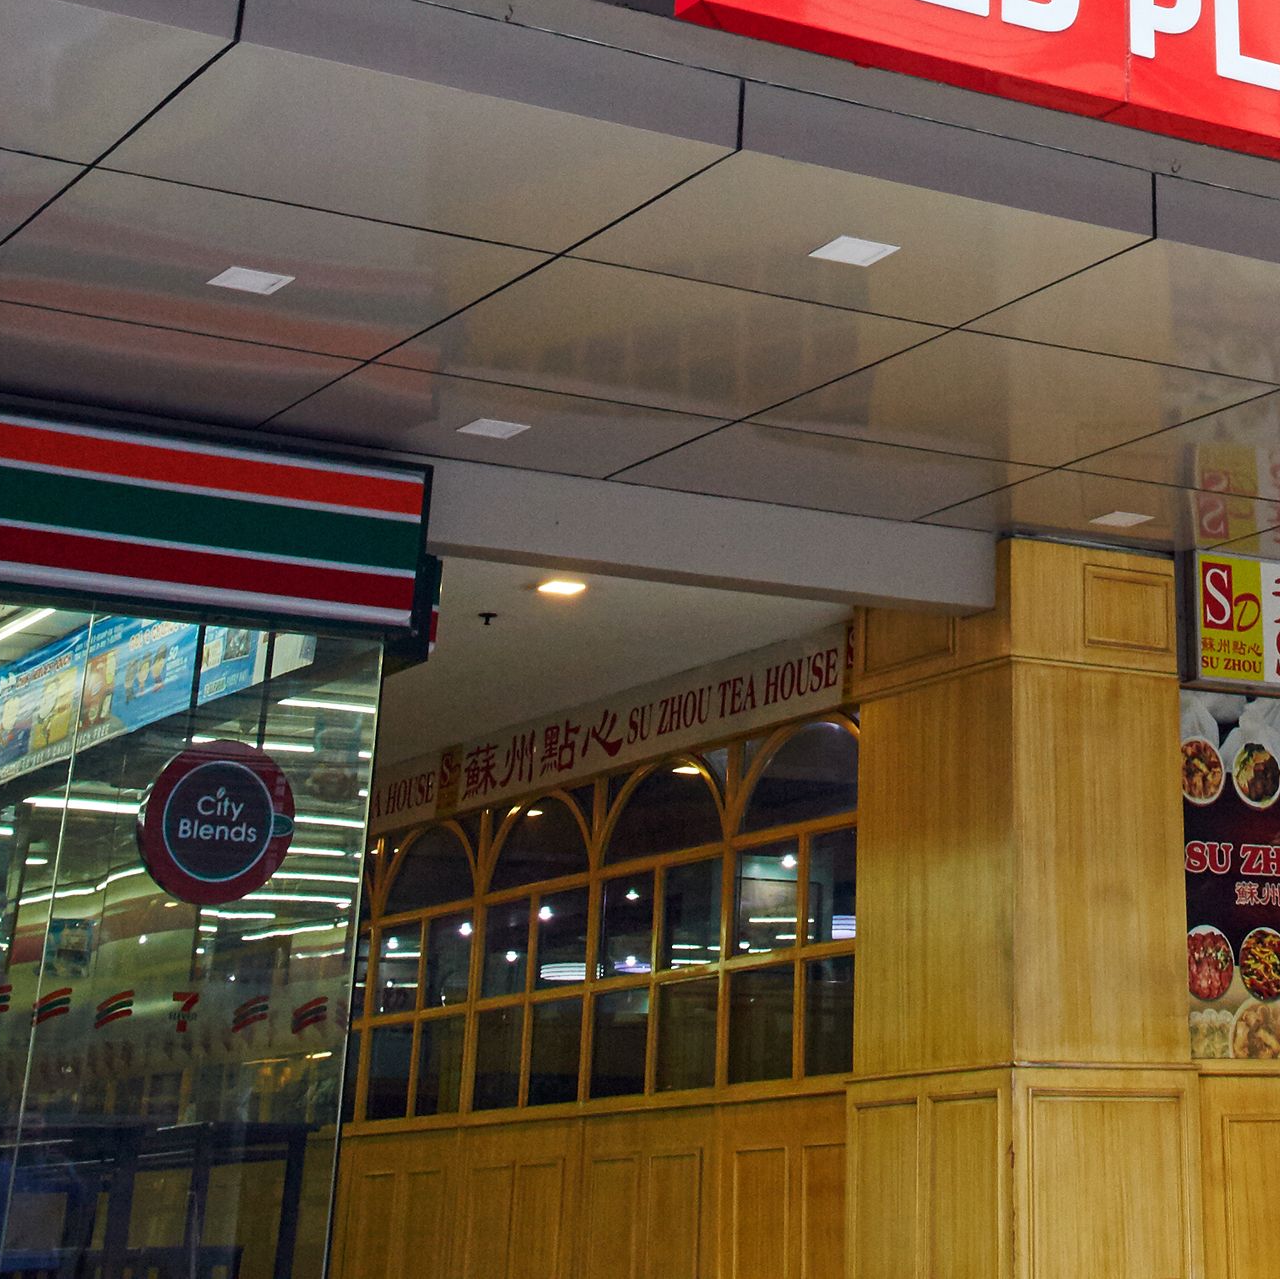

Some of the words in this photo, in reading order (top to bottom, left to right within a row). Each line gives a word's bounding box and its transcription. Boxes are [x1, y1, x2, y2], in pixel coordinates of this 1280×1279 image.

[1201, 655, 1219, 669] SU
[1223, 657, 1262, 674] ZHOU
[627, 703, 654, 745] SU
[656, 685, 713, 736] ZHOU
[717, 674, 757, 719] TEA
[763, 648, 839, 707] HOUSE
[461, 709, 623, 801] 蘇州點心
[197, 787, 245, 822] City
[385, 772, 436, 816] HOUSE
[178, 817, 258, 843] Blends
[1184, 840, 1233, 874] SU
